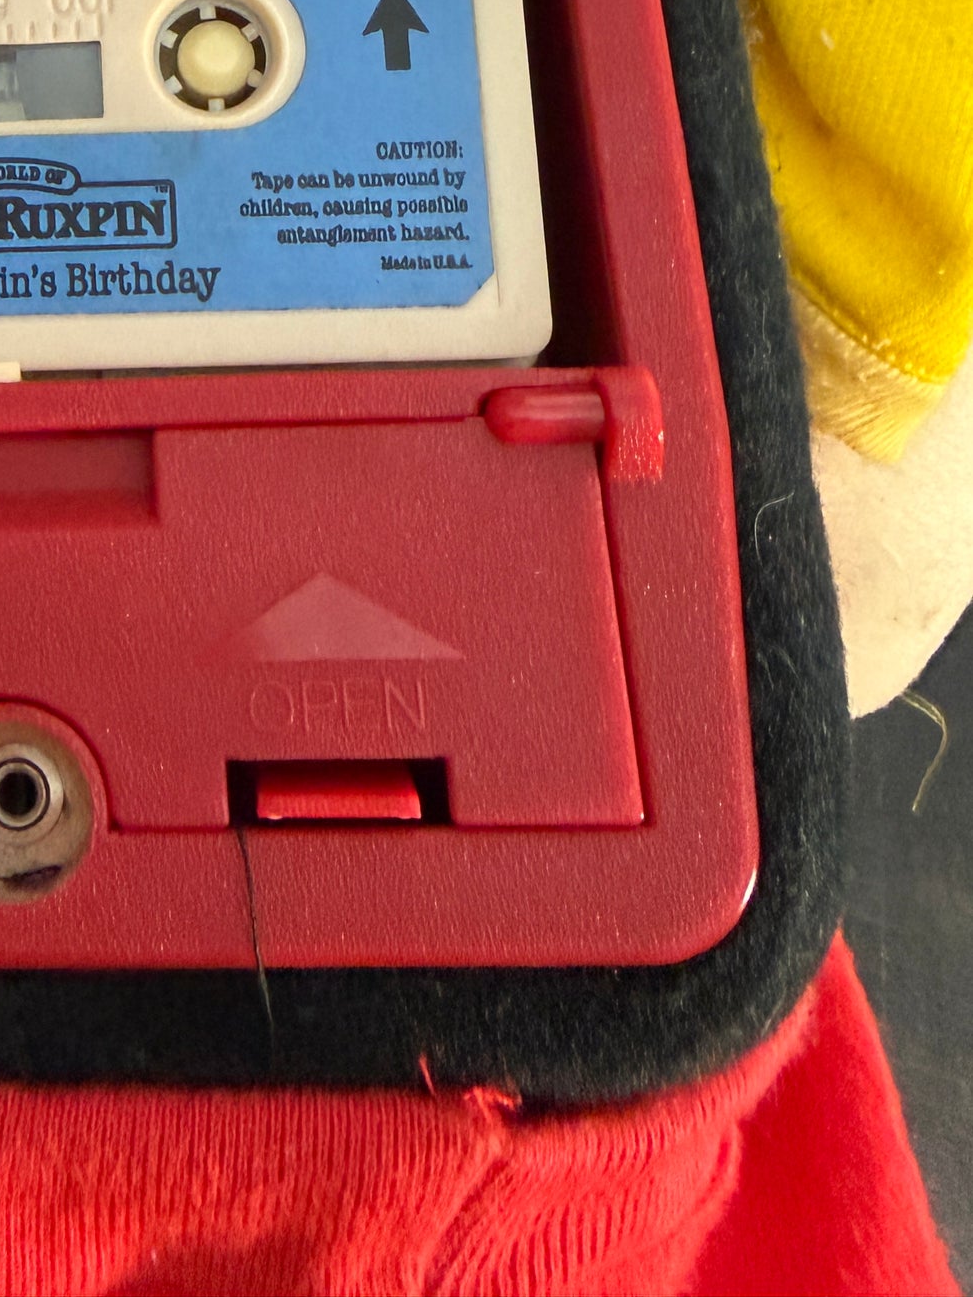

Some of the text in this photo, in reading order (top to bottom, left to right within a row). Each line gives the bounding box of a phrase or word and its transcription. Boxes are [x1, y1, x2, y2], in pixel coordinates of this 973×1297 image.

[376, 140, 463, 160] CAUTION:
[45, 169, 67, 184] OF
[251, 168, 466, 193] Tape can be unwound by
[240, 195, 468, 218] children, causing possible
[277, 222, 469, 247] entanglement hazard.
[381, 256, 416, 270] Made
[418, 256, 432, 270] in
[66, 261, 221, 303] Birthday
[250, 679, 426, 732] OPEN
